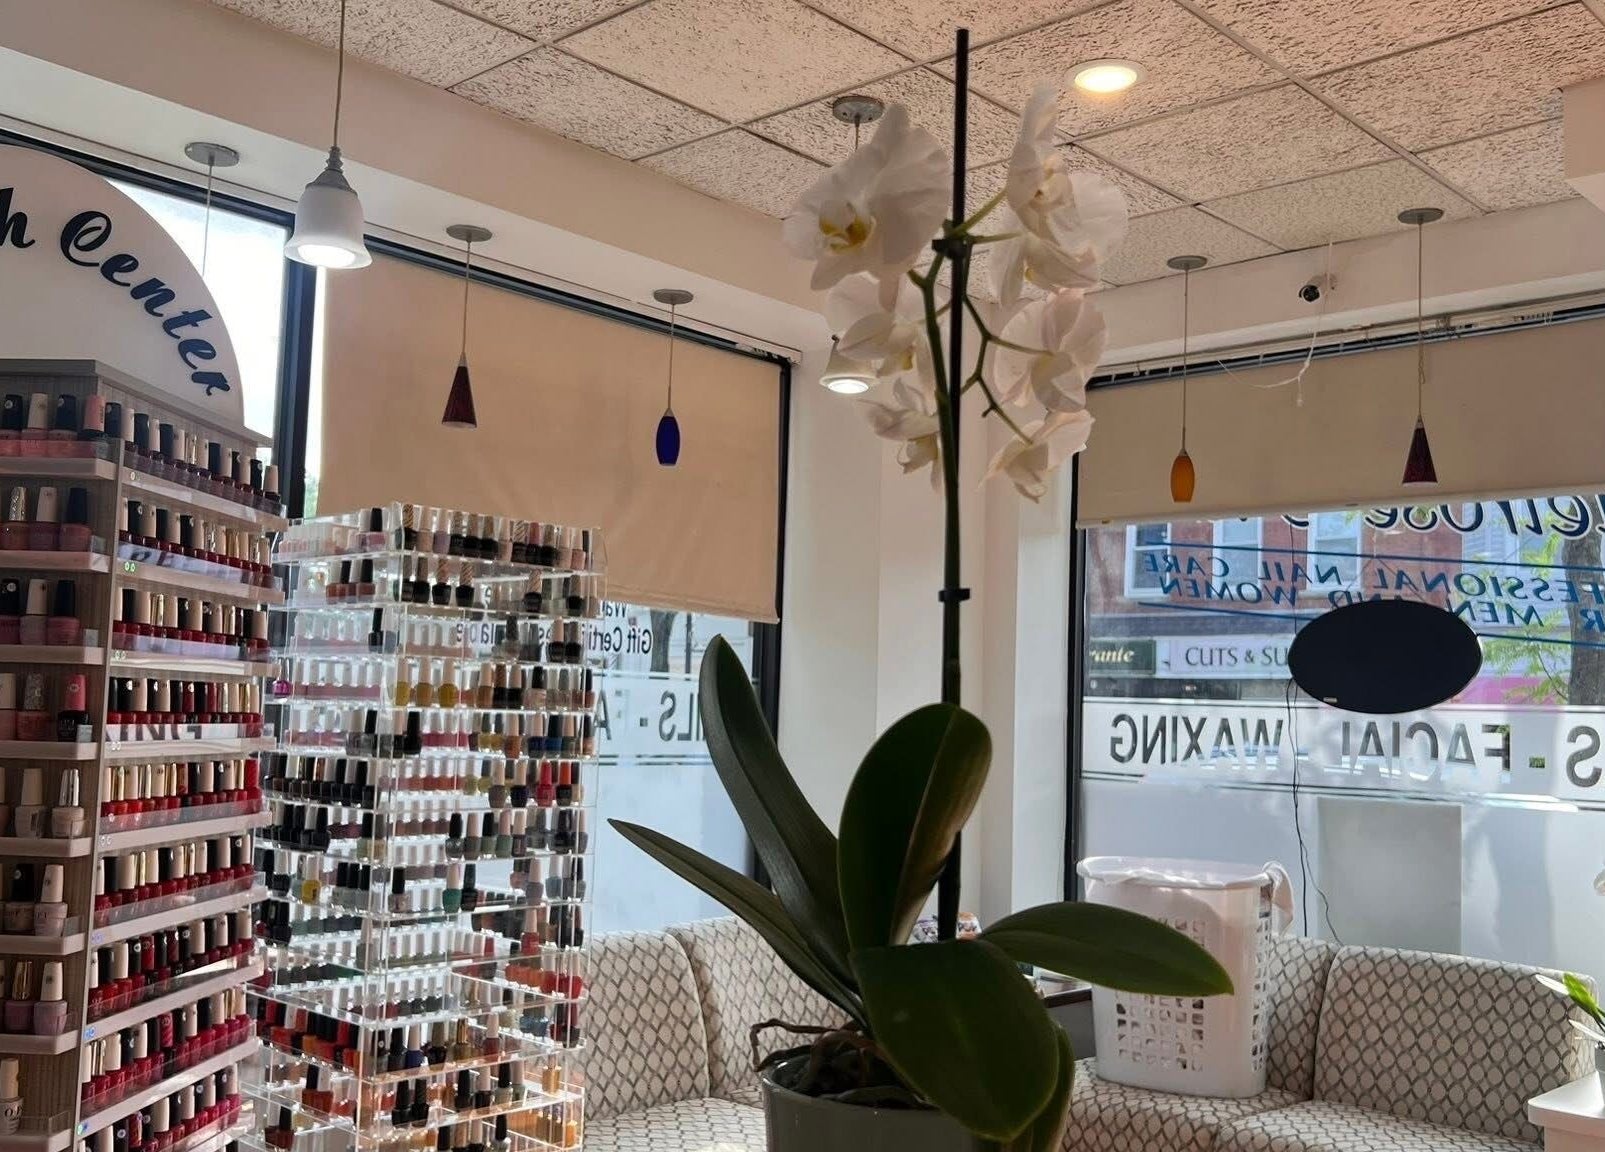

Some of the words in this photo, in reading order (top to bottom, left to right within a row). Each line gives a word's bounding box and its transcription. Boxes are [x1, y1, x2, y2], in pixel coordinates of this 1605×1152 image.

[60, 210, 231, 396] Center
[1185, 647, 1239, 667] CUTS
[1244, 648, 1256, 666] &
